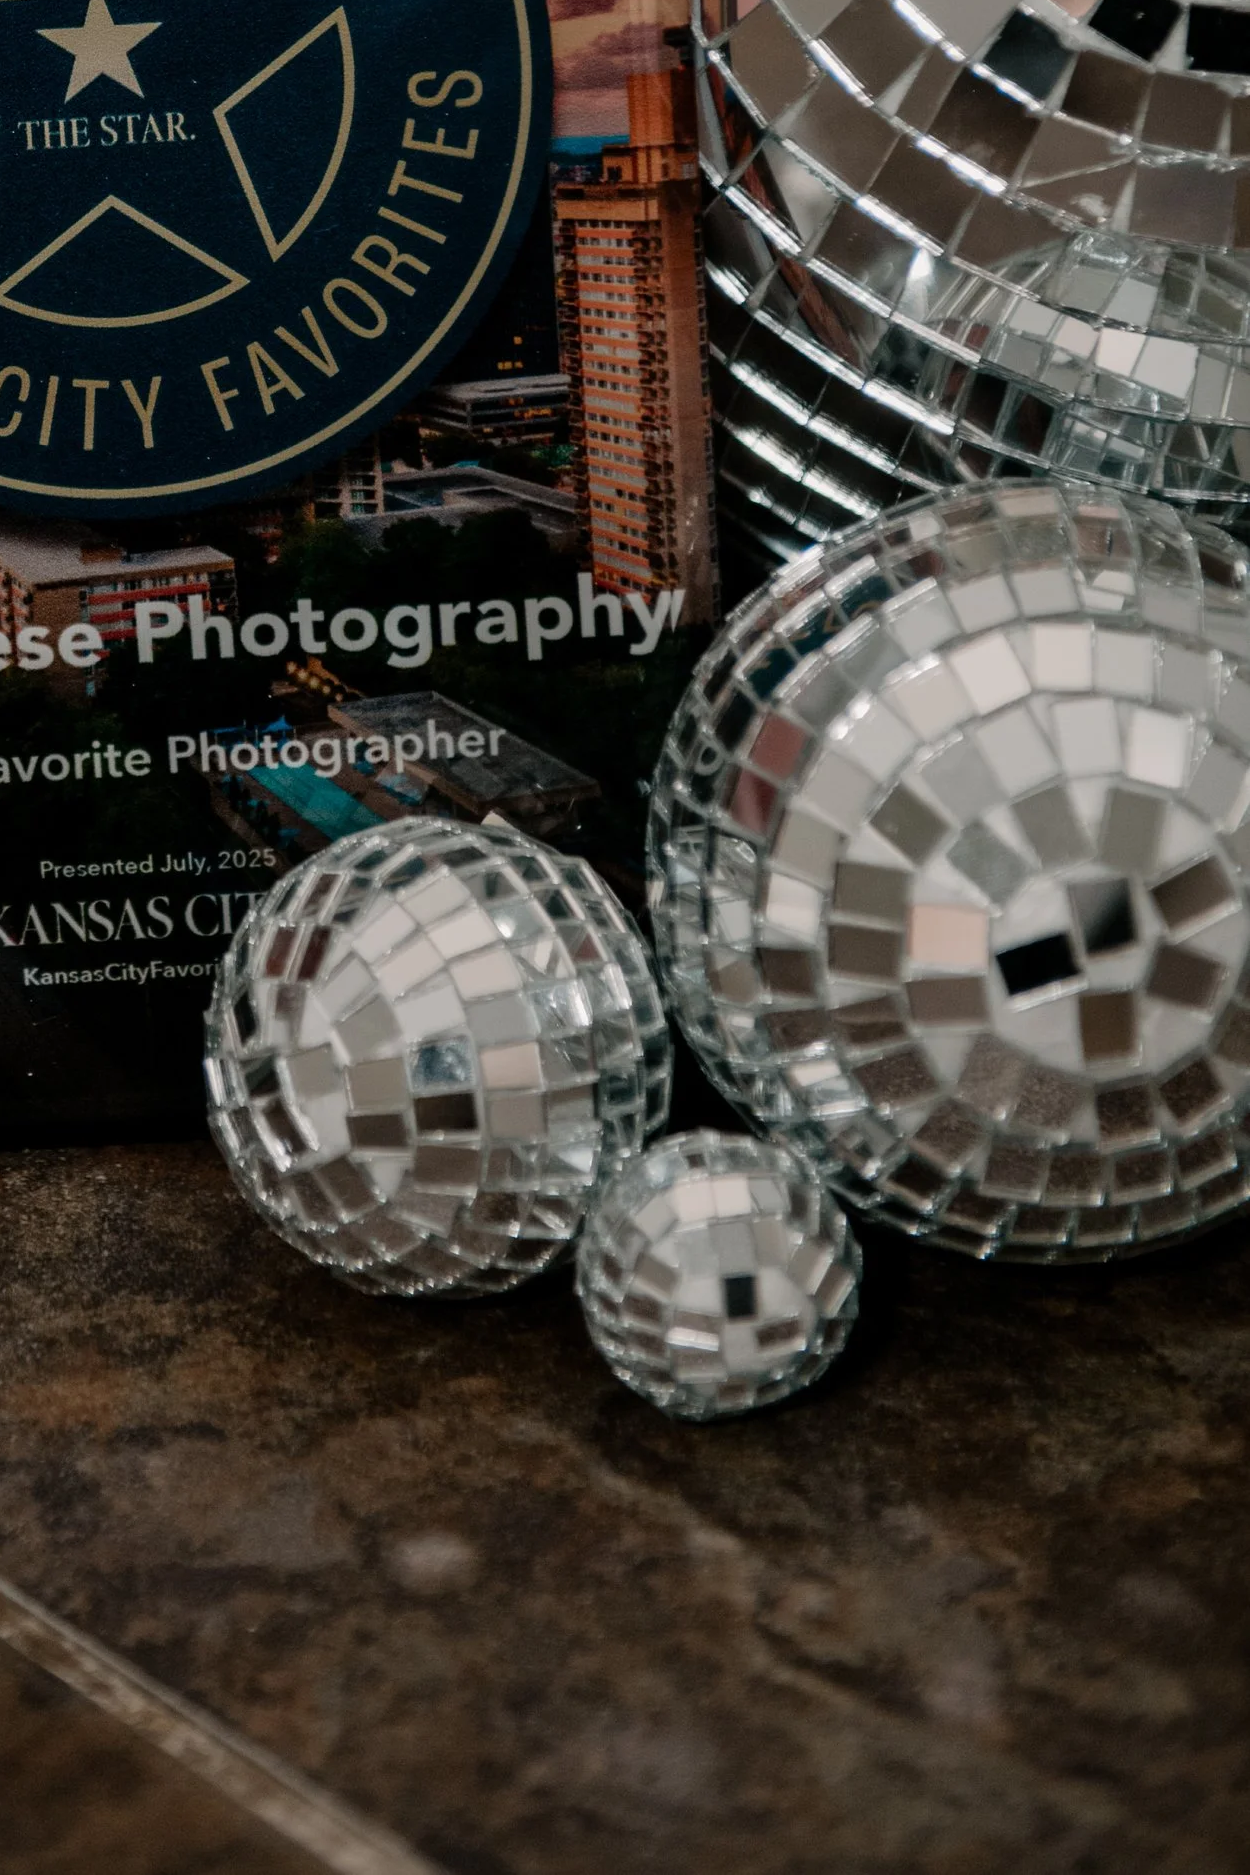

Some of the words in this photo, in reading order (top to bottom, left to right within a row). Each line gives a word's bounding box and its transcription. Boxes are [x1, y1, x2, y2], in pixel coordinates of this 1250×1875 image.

[17, 116, 91, 150] THE
[200, 68, 483, 433] FAVORITES
[134, 571, 678, 669] Photography
[167, 719, 506, 778] Photographer
[39, 853, 154, 880] Presented
[160, 850, 212, 876] July,
[217, 848, 278, 870] 2025
[183, 890, 269, 938] CIT
[23, 957, 220, 985] KansasCityFavori
